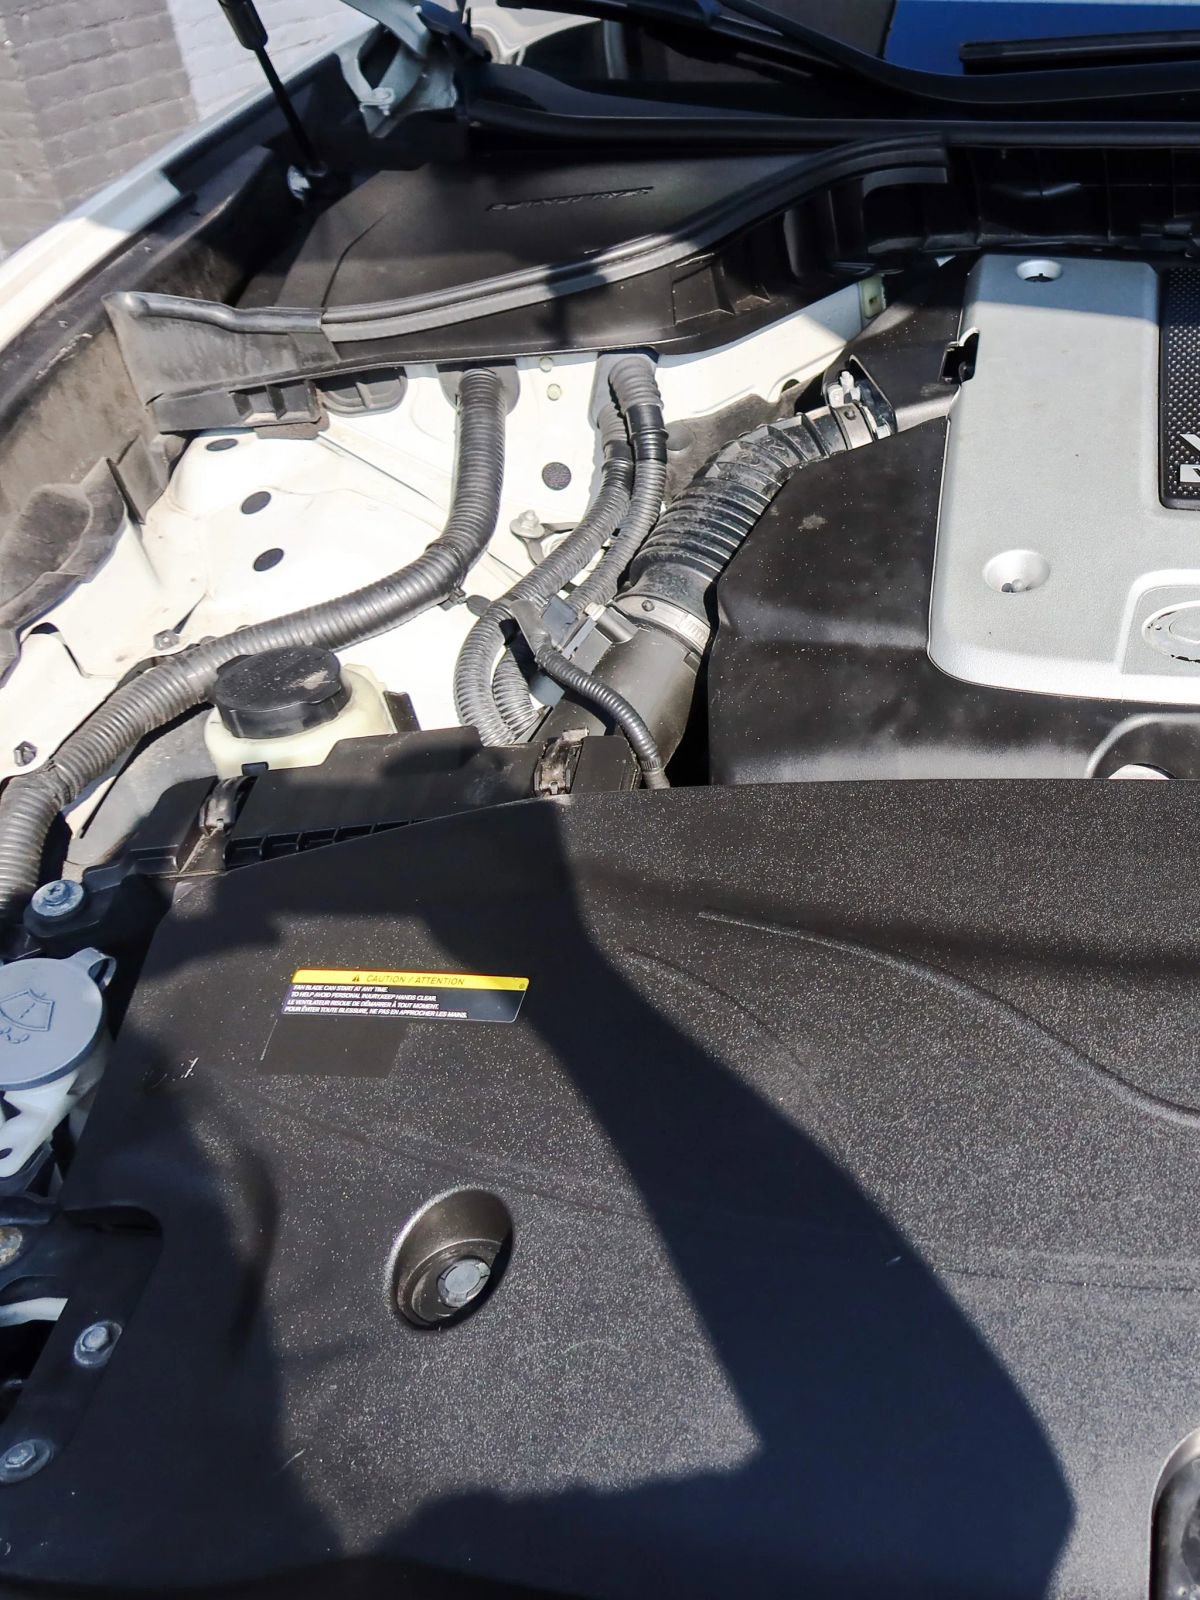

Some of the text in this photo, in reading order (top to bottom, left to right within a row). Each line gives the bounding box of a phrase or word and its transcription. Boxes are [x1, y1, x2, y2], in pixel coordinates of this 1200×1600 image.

[366, 974, 406, 983] CAUTION
[414, 976, 465, 986] ATTENTION
[399, 1009, 436, 1017] APPROCHER
